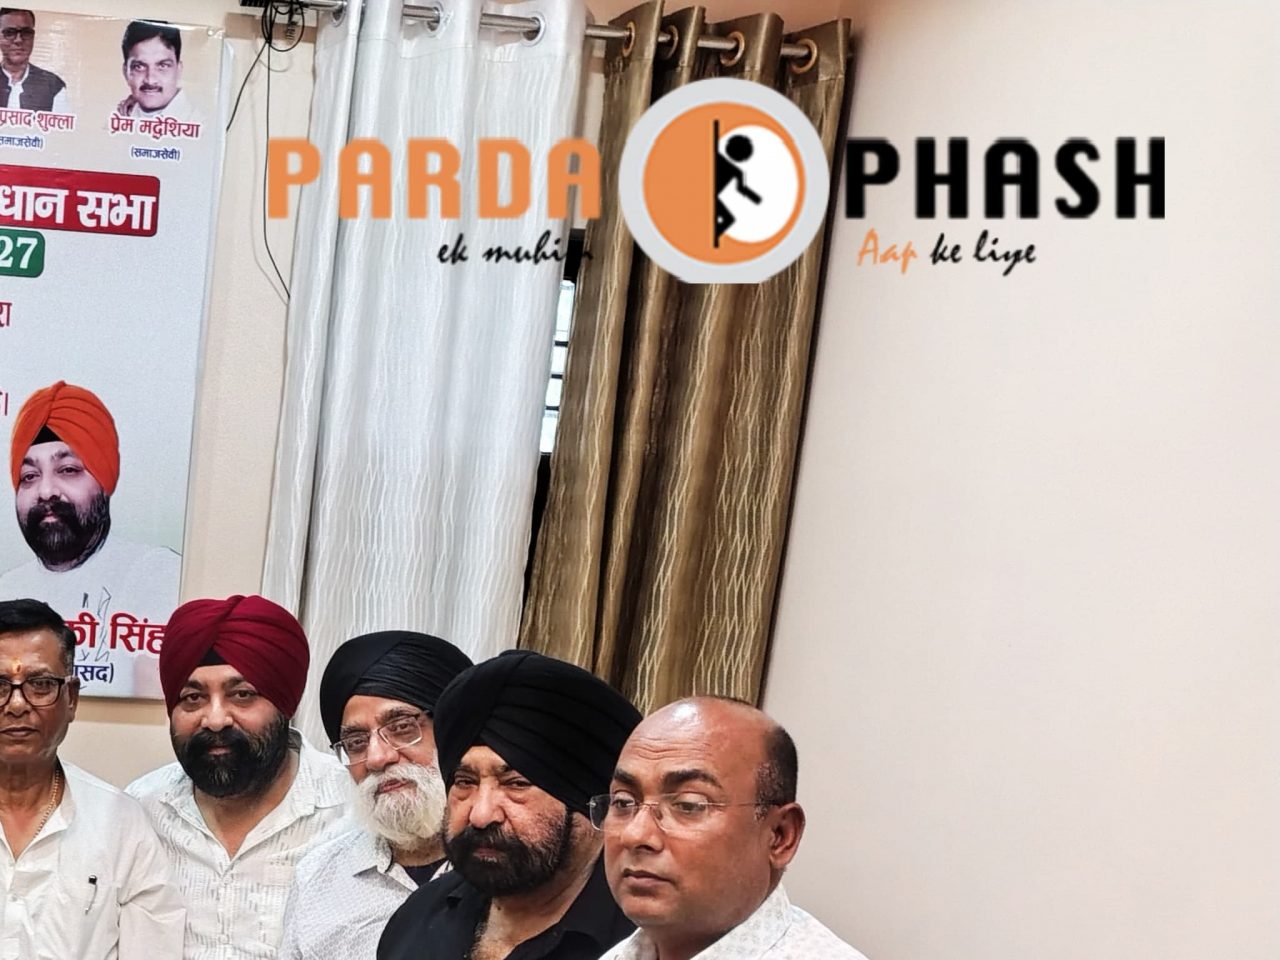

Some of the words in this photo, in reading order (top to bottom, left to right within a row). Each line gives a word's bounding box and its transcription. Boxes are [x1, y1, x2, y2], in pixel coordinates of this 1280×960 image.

[36, 111, 75, 133] शुक्ला
[110, 113, 134, 135] प्रेम
[131, 145, 181, 162] (समाजसेवी)
[76, 188, 157, 232] सभा
